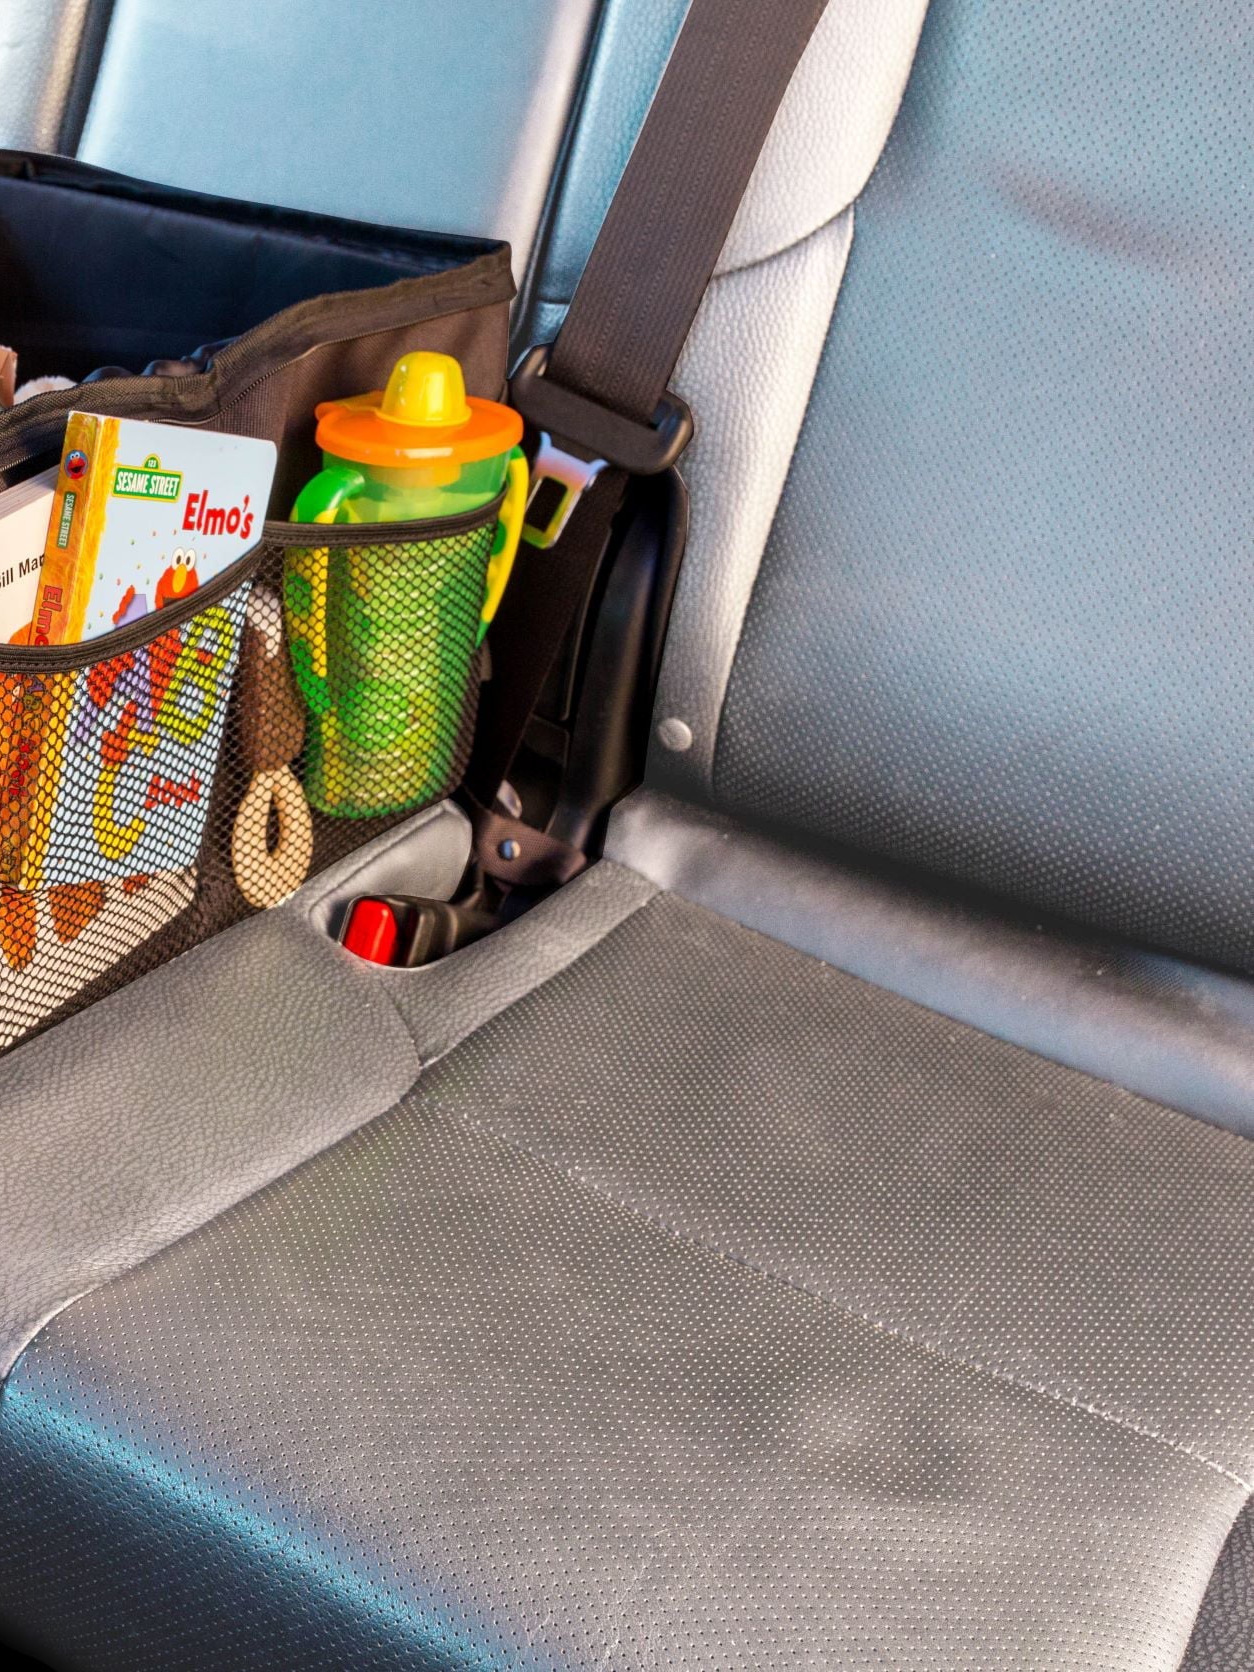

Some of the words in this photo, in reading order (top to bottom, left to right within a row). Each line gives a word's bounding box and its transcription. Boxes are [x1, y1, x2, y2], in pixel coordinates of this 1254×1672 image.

[147, 459, 157, 468] 123
[115, 470, 149, 494] SESAME
[149, 474, 180, 497] STREET
[62, 493, 75, 522] SESAME
[181, 489, 255, 540] Elmo's
[58, 520, 71, 547] STREET
